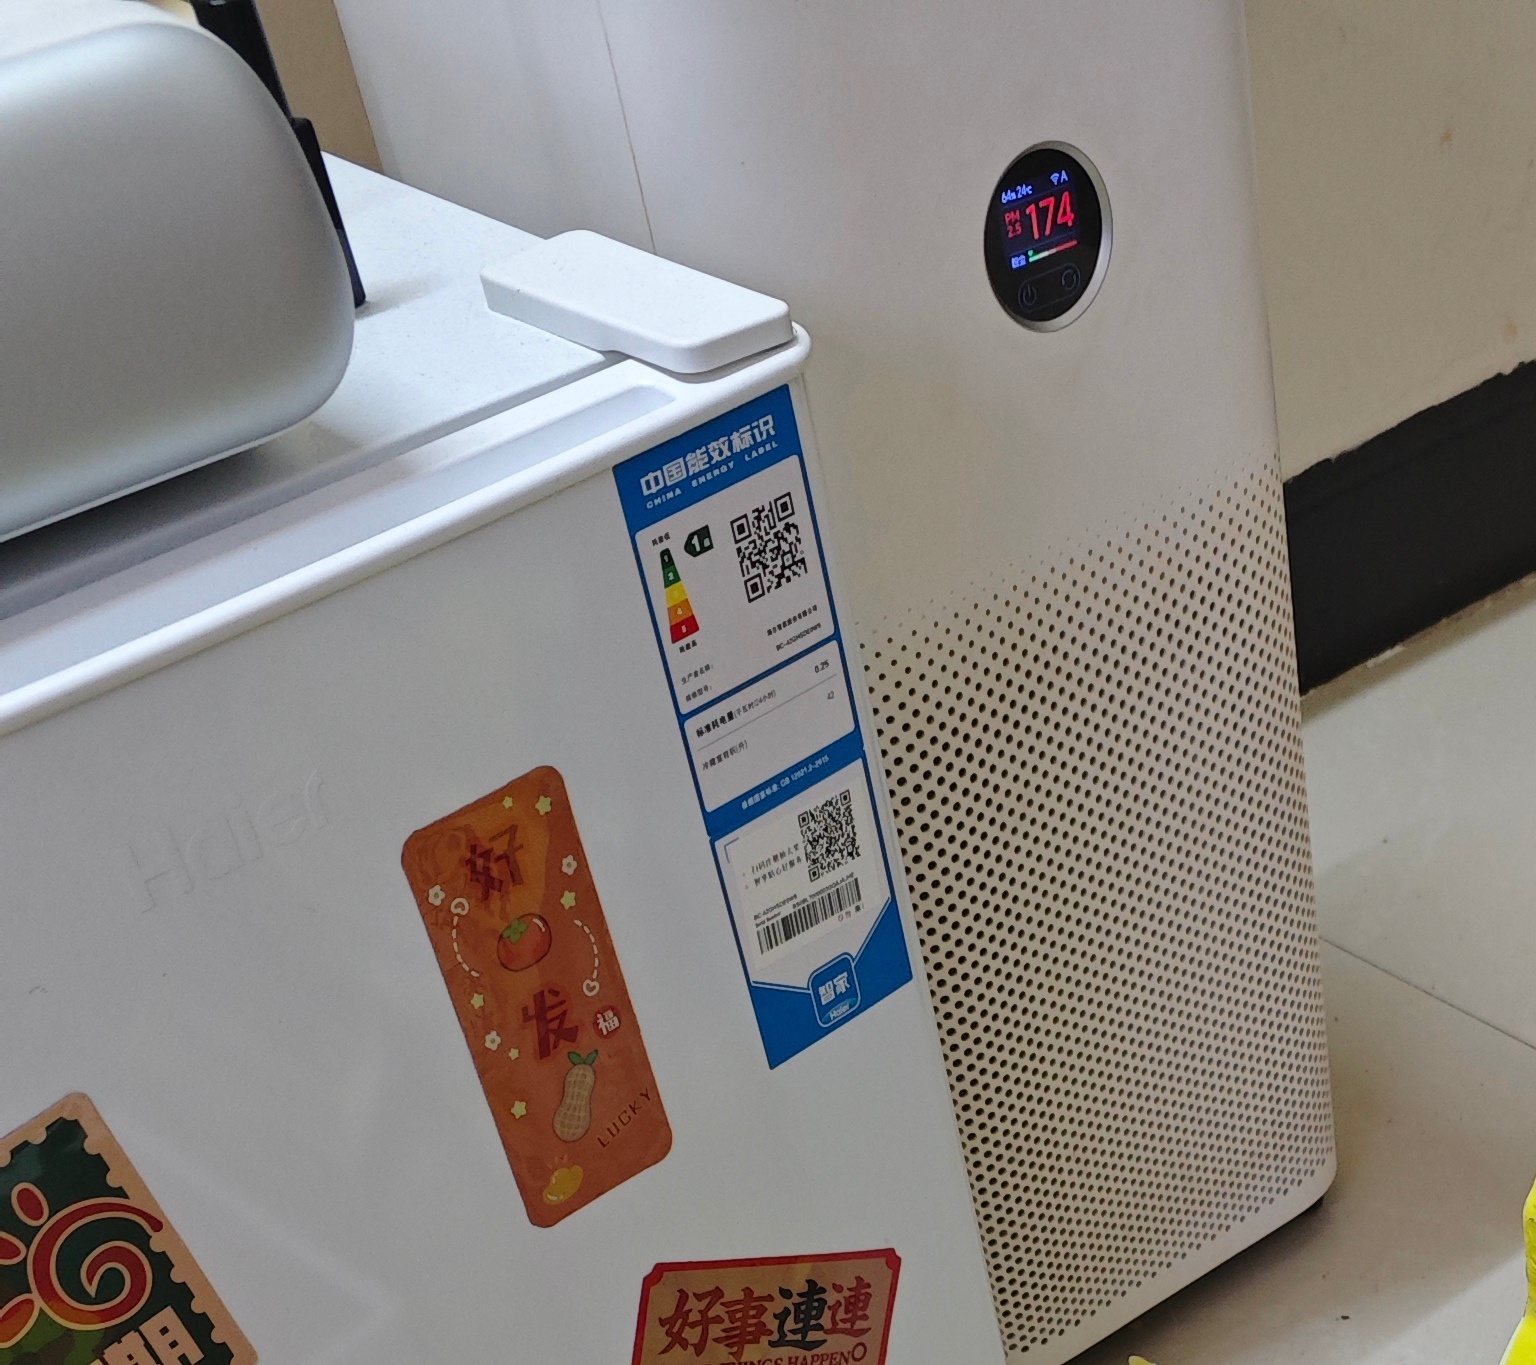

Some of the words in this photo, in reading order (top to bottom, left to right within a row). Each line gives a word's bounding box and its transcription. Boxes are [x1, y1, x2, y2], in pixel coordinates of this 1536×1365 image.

[1026, 191, 1075, 241] 174
[639, 414, 776, 497] 中国能效标识
[646, 487, 682, 509] CHINA
[691, 462, 735, 488] ENERGY
[125, 769, 329, 916] Haier
[596, 1010, 620, 1036] 福
[597, 1087, 653, 1149] LUCKY
[658, 1275, 873, 1360] 好事連連
